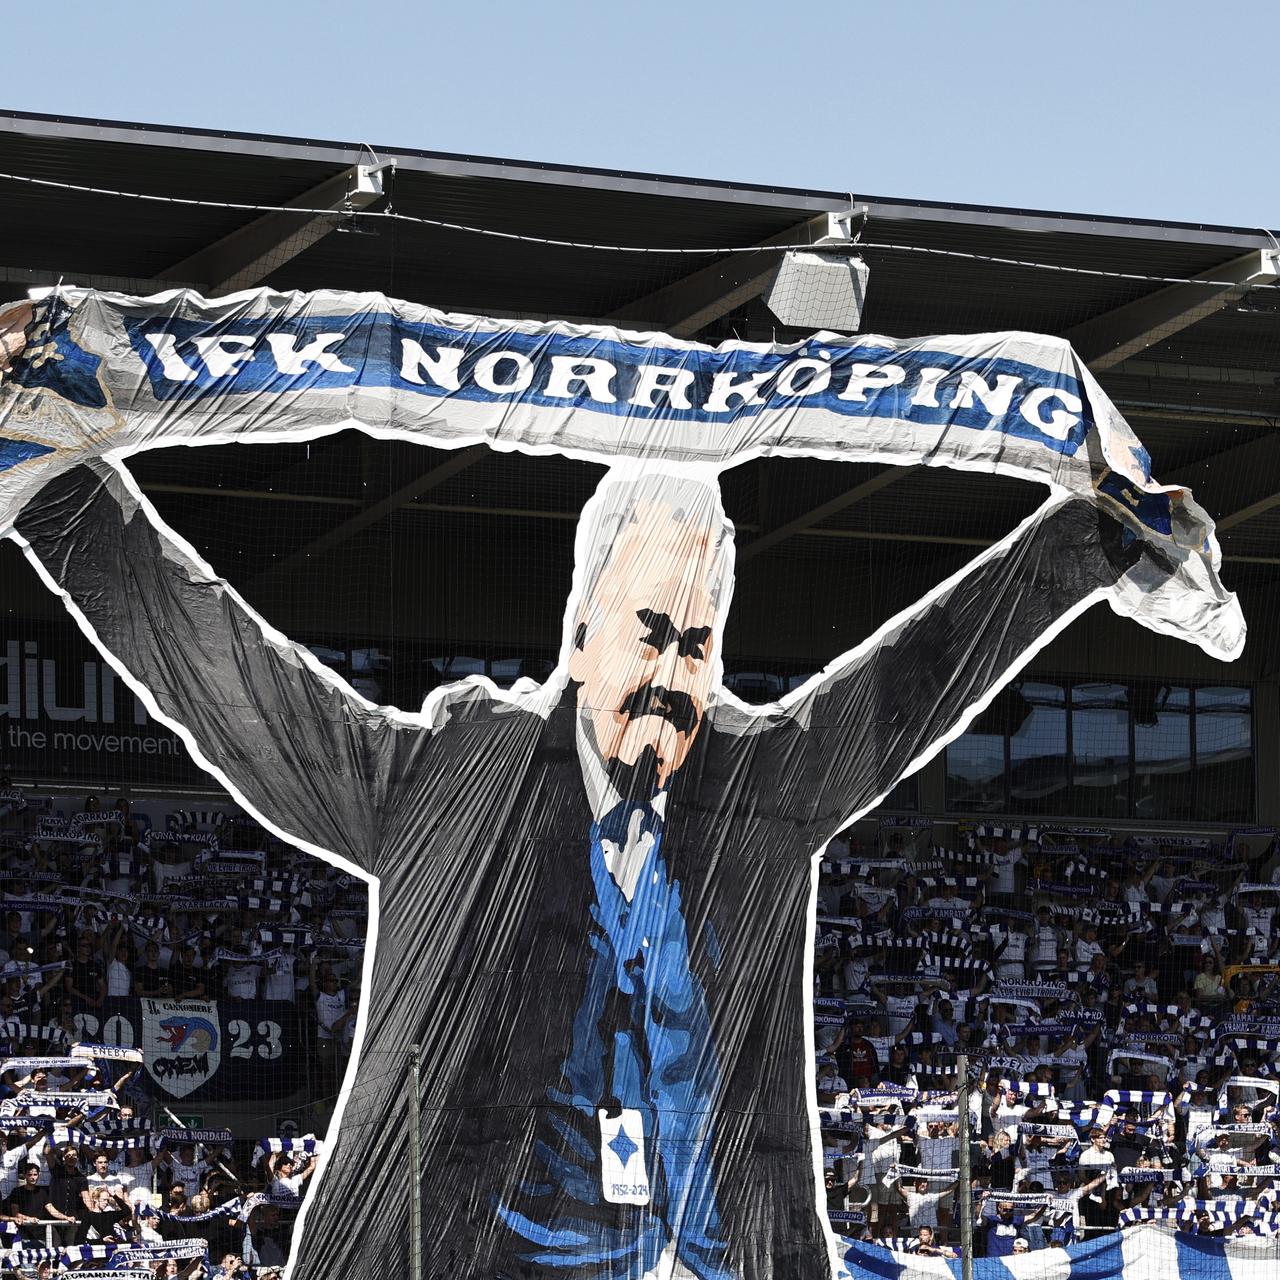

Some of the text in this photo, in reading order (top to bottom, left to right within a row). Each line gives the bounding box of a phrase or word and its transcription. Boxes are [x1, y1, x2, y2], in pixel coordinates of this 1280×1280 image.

[144, 331, 1083, 441] IFK NORRKÖPING
[8, 723, 47, 750] the
[1001, 977, 1067, 990] NORRKÖPING
[227, 1018, 283, 1060] 23
[93, 1046, 128, 1059] ENEBY
[162, 1129, 233, 1143] CURVA NORDAHL
